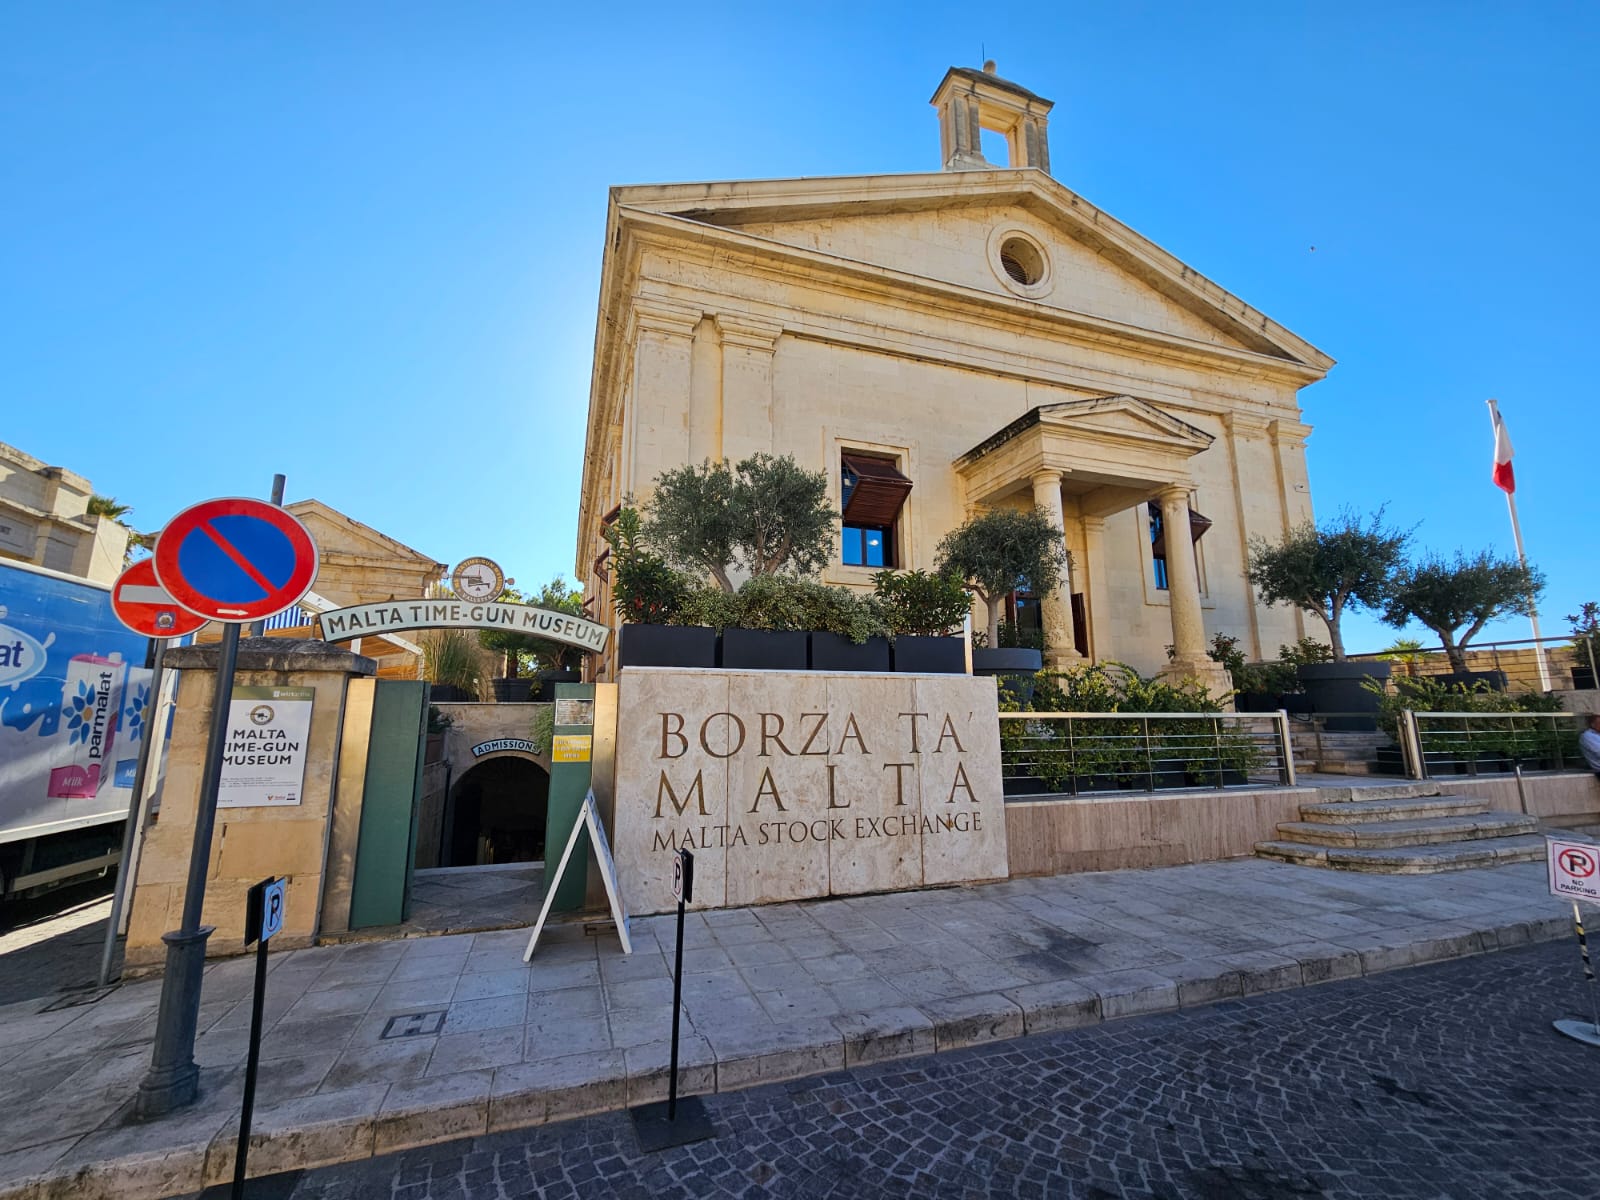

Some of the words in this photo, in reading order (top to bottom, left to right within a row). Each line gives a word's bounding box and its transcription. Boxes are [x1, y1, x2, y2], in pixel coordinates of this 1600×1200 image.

[327, 607, 402, 634] MALTA
[409, 605, 516, 625] TIME-GUN
[522, 611, 605, 645] MUSEUM
[89, 671, 113, 759] parmalat
[233, 729, 287, 739] MALTA
[478, 740, 539, 754] ADMISSIONS
[657, 711, 871, 759] BORZA
[223, 755, 292, 765] MUSEUM
[651, 760, 980, 819] MALTA
[652, 824, 747, 851] MALTA
[758, 818, 846, 845] STOCK
[856, 811, 983, 839] EXCHANGE
[1560, 883, 1597, 895] PARKING
[1571, 879, 1584, 887] NO
